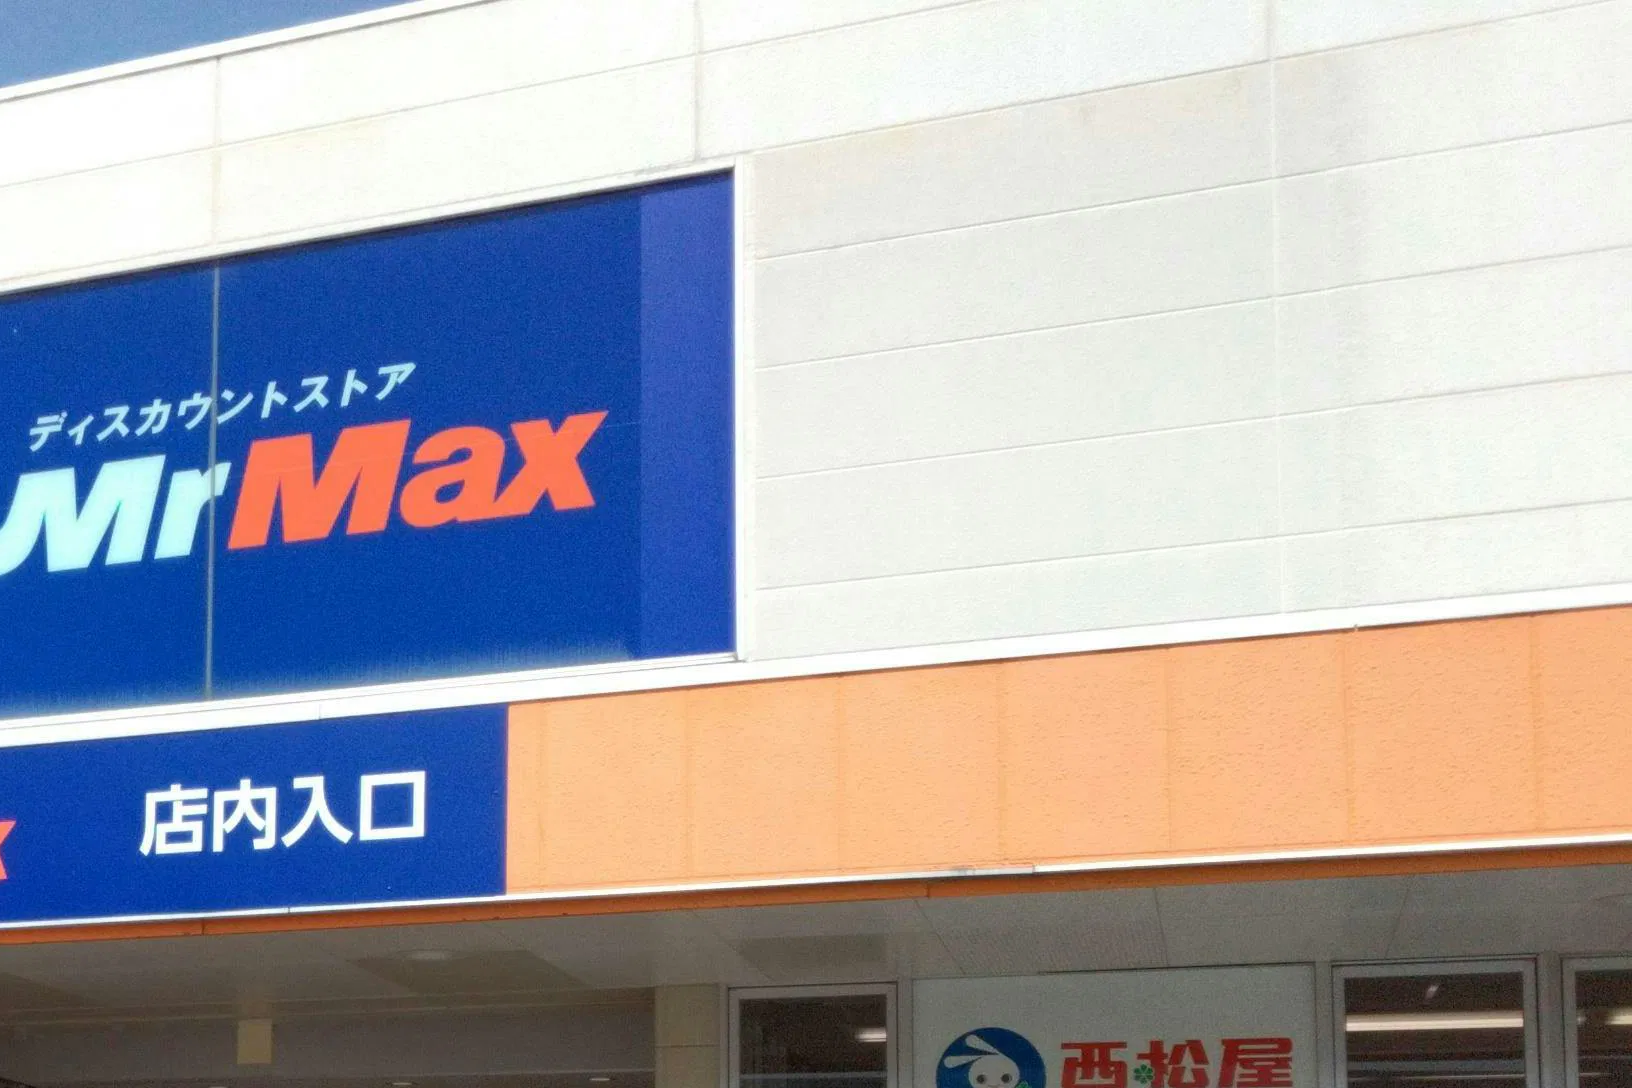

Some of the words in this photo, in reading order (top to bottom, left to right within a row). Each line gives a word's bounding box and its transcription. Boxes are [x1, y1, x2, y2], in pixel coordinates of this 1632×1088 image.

[29, 362, 416, 452] ディスカウントストア
[139, 770, 426, 857] 店内入口
